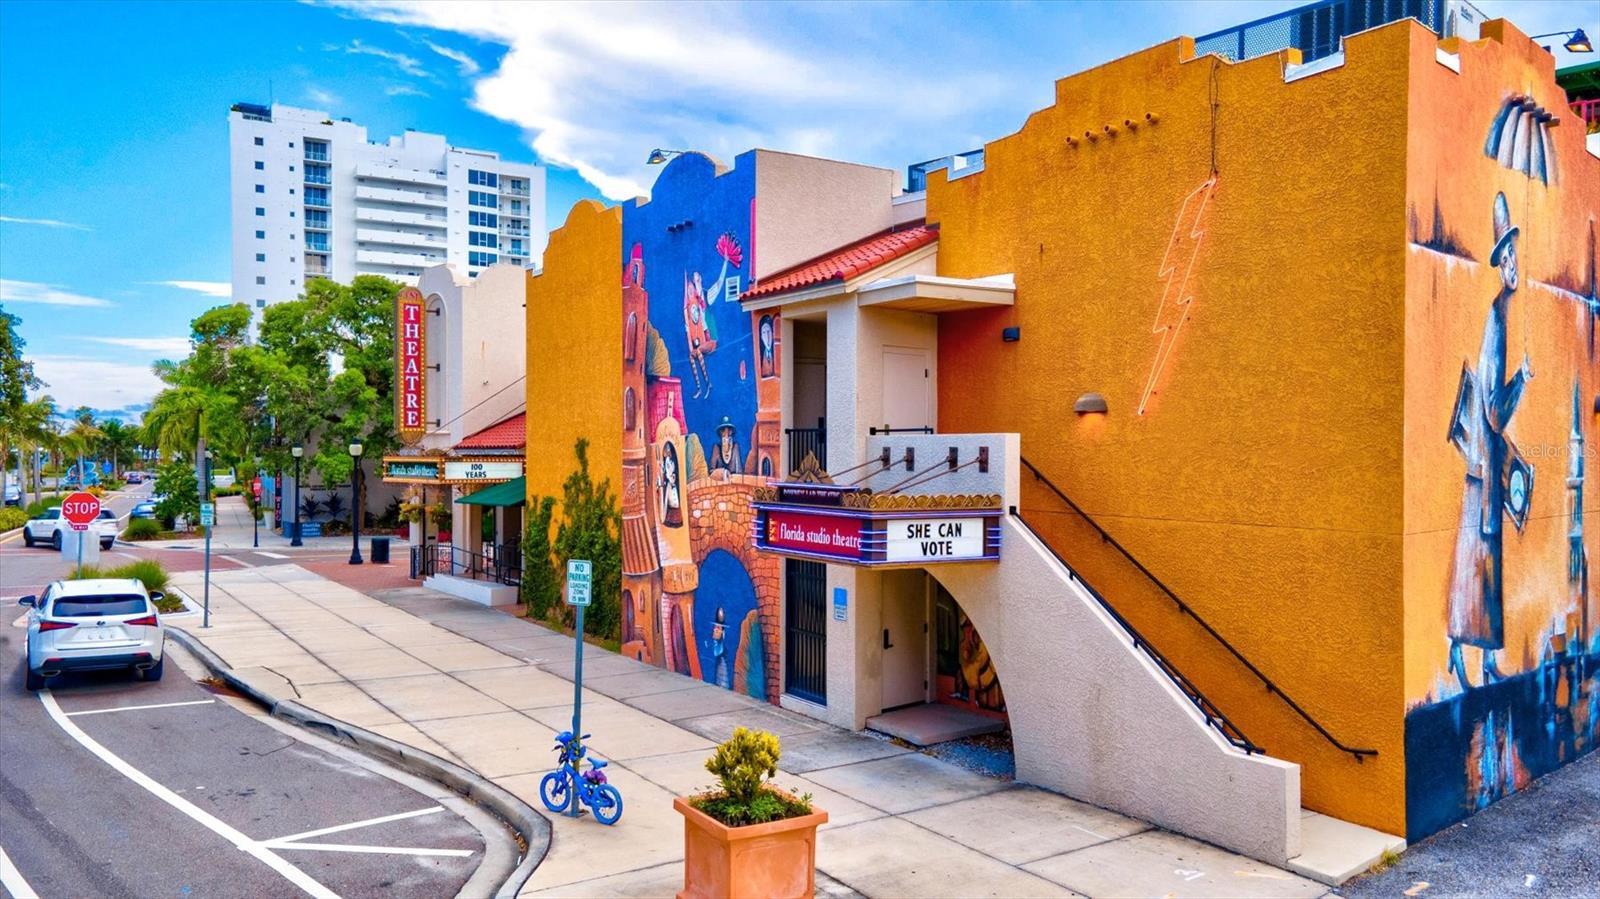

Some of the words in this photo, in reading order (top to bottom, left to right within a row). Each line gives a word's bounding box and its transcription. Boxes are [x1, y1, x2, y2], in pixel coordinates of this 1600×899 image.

[404, 304, 419, 427] THEATRE
[470, 463, 483, 471] 100
[465, 471, 487, 479] YEARS
[64, 502, 98, 515] STOP
[780, 522, 805, 542] florida
[806, 527, 831, 545] studio
[832, 528, 862, 549] theatre
[907, 523, 931, 539] SHE
[938, 522, 962, 538] CAN
[921, 541, 953, 556] VOTE
[575, 564, 584, 572] NO
[569, 573, 589, 582] PARKING
